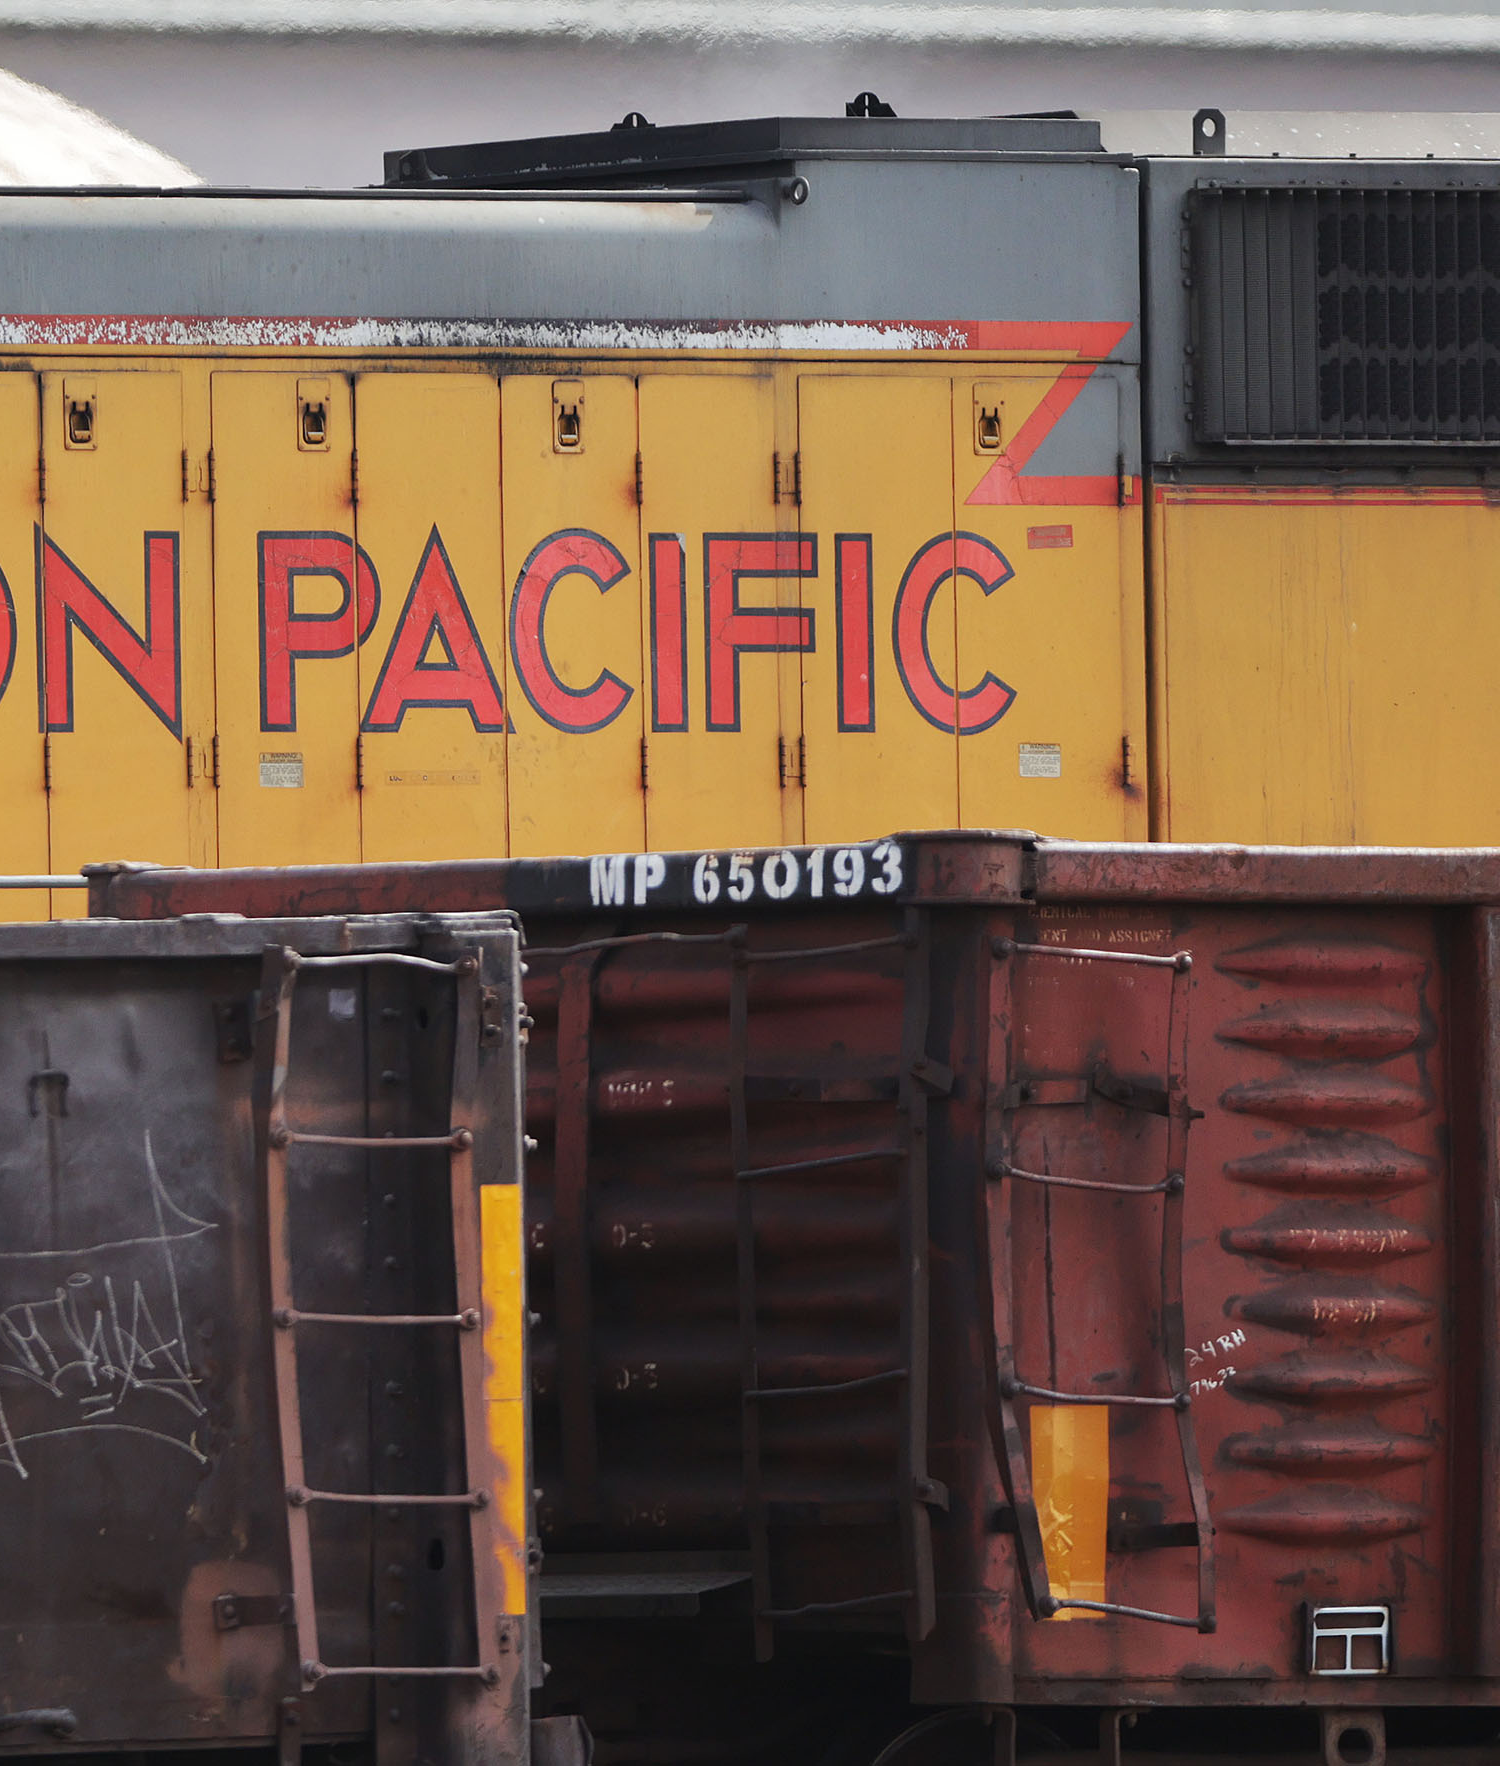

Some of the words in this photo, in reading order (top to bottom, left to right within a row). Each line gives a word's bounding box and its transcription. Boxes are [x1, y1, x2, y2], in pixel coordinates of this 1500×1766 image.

[257, 523, 1018, 736] PACIFIC
[590, 853, 666, 907] MP
[693, 845, 903, 904] 650193
[1184, 1340, 1217, 1367] 24
[1216, 1328, 1246, 1352] RH
